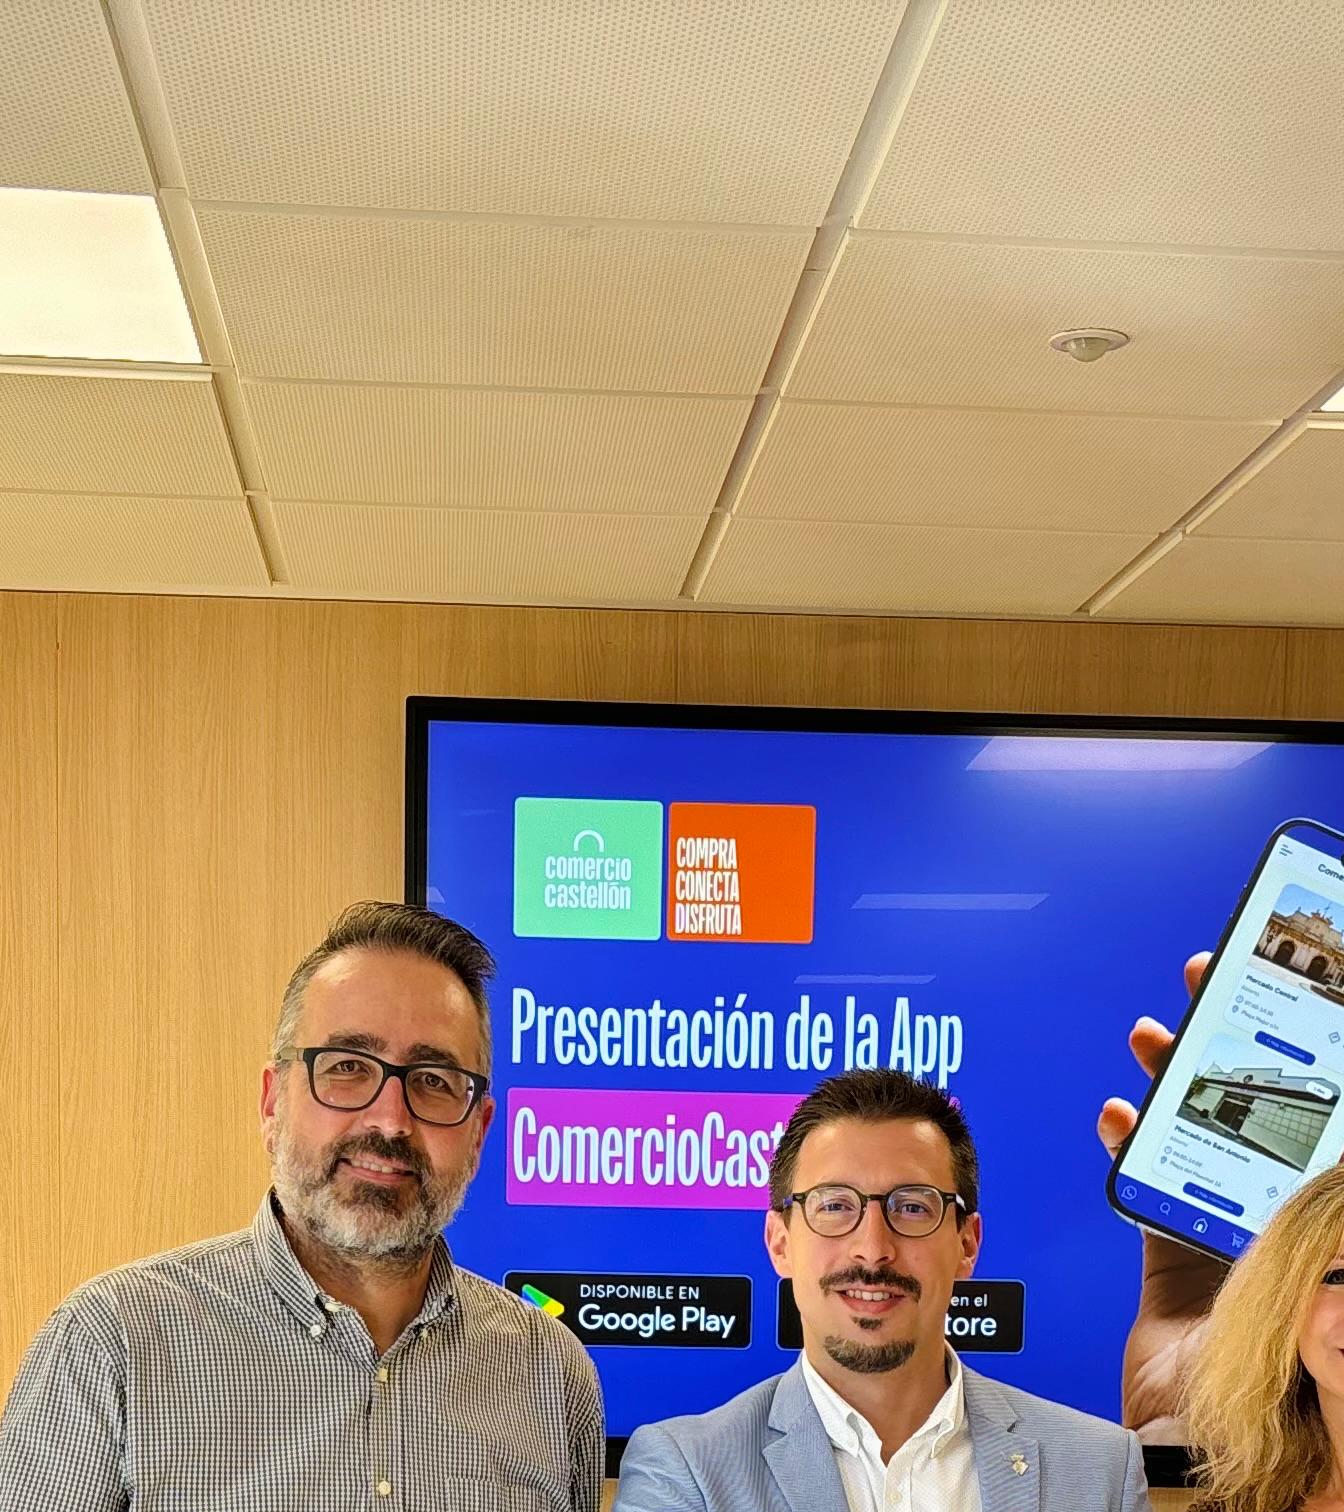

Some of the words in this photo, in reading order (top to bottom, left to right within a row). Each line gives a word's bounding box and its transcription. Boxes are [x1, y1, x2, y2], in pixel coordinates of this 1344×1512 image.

[545, 856, 632, 881] comercio
[676, 837, 738, 869] COMPRA
[544, 881, 631, 910] castellón
[675, 870, 740, 902] CONECTA
[675, 902, 742, 935] DISFRUTA
[512, 987, 774, 1070] Presentación
[786, 995, 833, 1072] de
[845, 995, 879, 1070] la
[889, 997, 963, 1090] App
[514, 1106, 784, 1188] ComercioCas
[579, 1284, 675, 1300] DISPONIBLE
[678, 1285, 700, 1300] EN
[950, 1296, 969, 1307] en
[974, 1293, 988, 1307] el
[578, 1304, 677, 1338] Google
[683, 1306, 736, 1339] Play
[944, 1313, 998, 1337] tore
